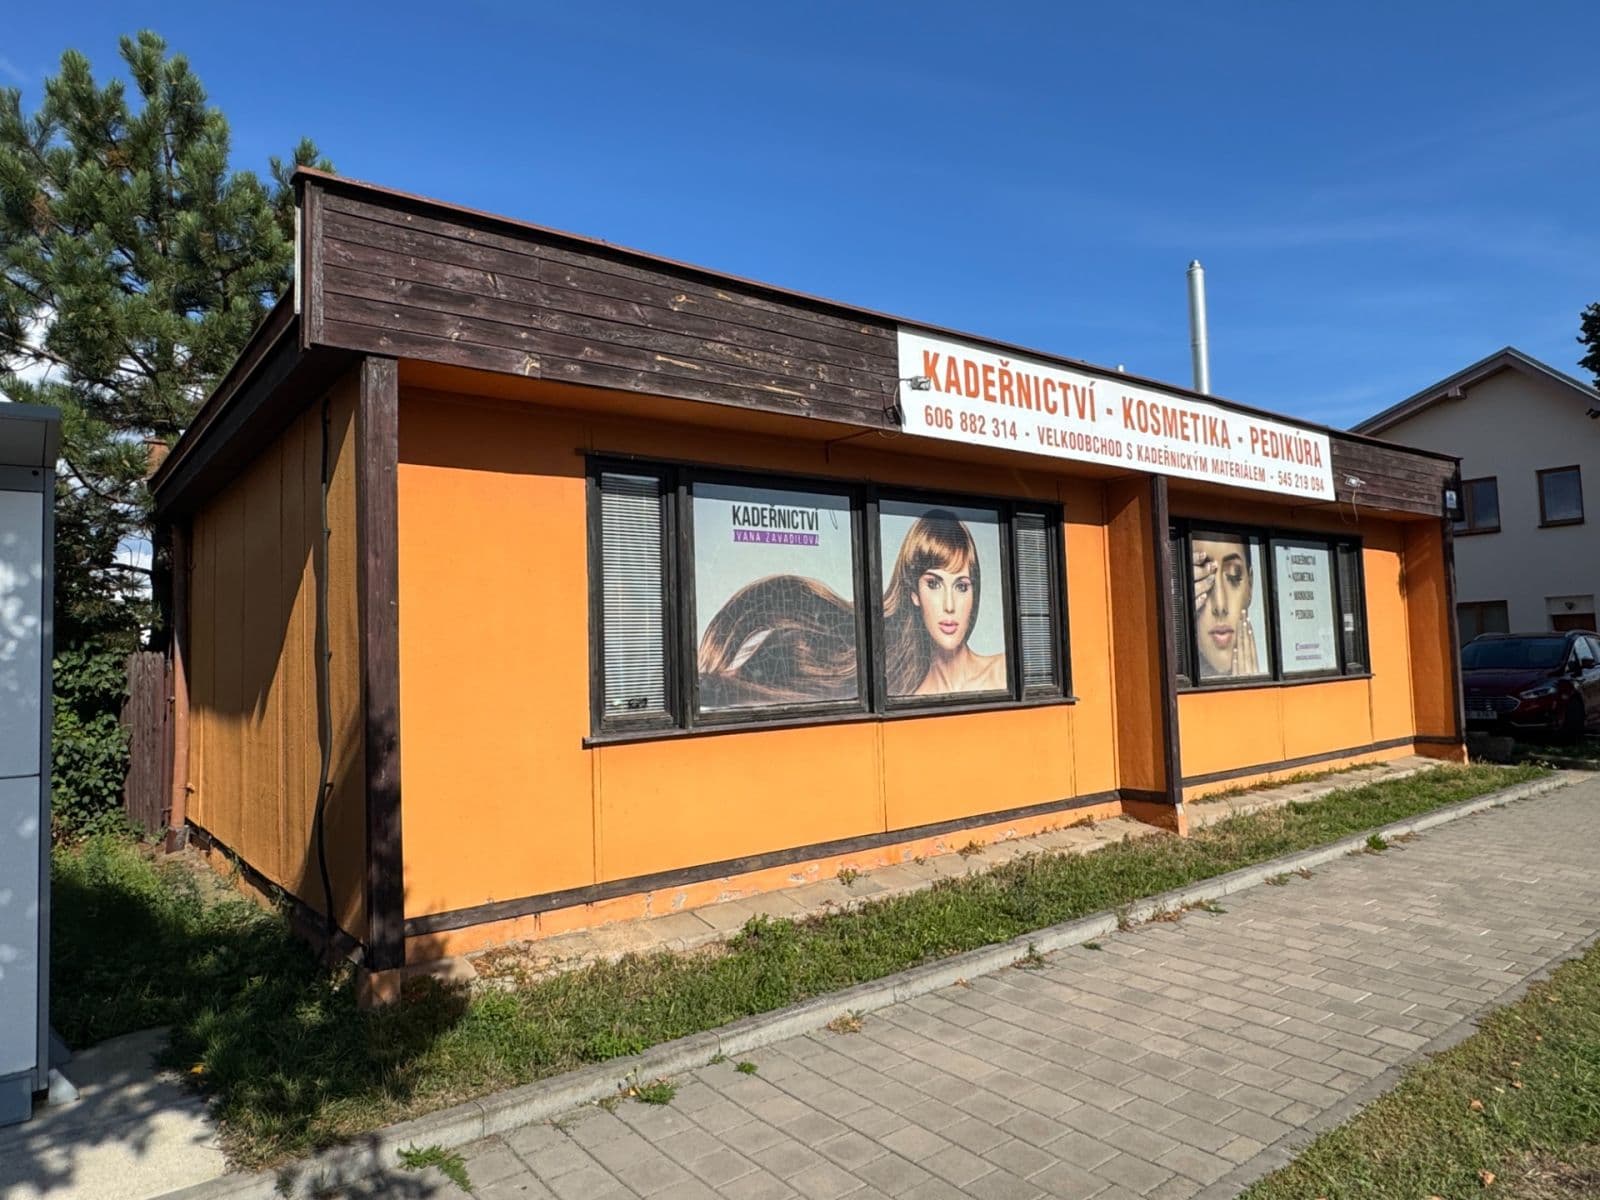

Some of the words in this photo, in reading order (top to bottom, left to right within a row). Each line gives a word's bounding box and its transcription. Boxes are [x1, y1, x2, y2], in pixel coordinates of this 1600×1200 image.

[923, 350, 1096, 422] KADEŘNICTVÍ
[1121, 396, 1231, 449] KOSMETIKA
[1249, 426, 1322, 468] PEDIKÚRA
[924, 405, 953, 429] 606
[960, 411, 987, 435] 882
[992, 418, 1018, 440] 314
[1037, 425, 1122, 457] VELKOOBCHOD
[1126, 442, 1133, 460] S
[1137, 445, 1208, 472] KADEŘNICKÝM
[1211, 459, 1266, 482] MATERIÁLEM
[1278, 470, 1292, 487] 545
[732, 504, 819, 531] KADEŘNICTVÍ
